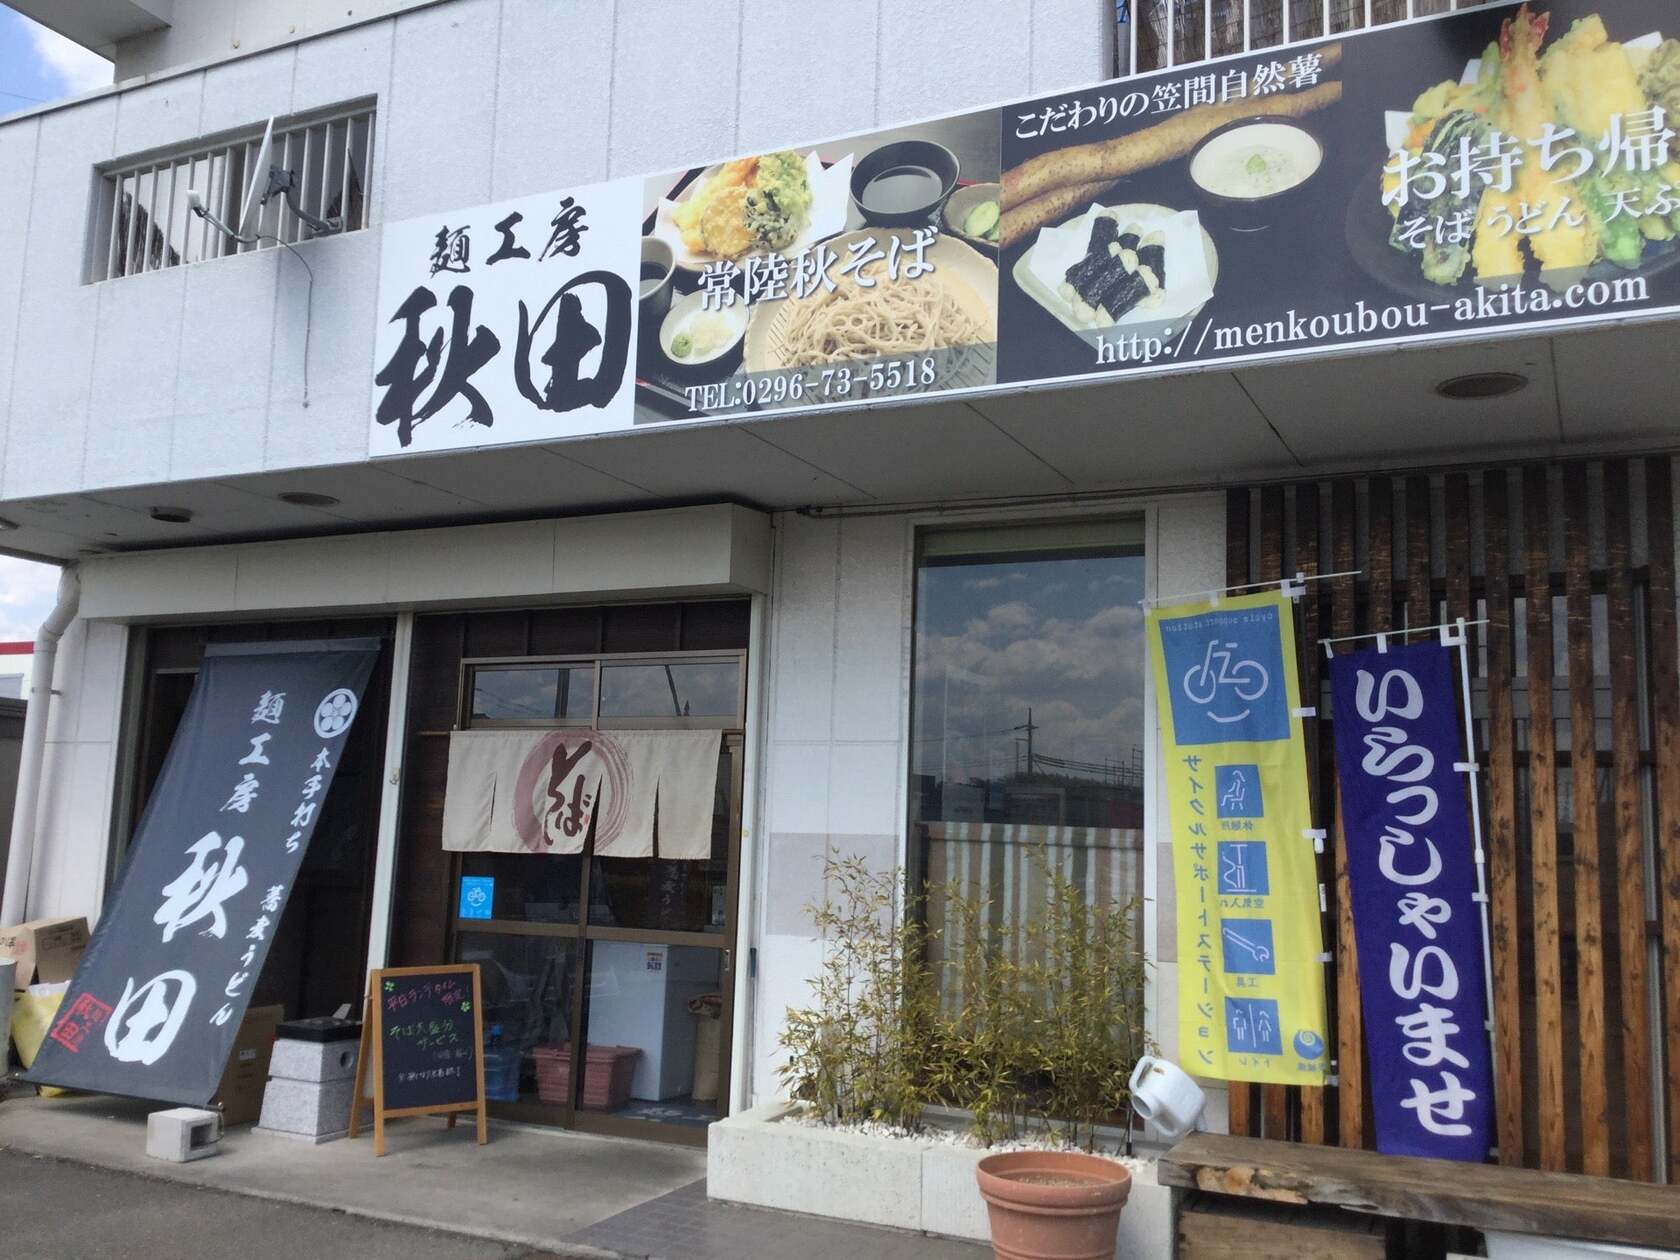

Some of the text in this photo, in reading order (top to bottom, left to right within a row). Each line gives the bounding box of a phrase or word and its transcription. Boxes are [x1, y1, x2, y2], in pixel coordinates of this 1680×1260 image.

[1015, 52, 1323, 138] こだわりの笠間自然薯
[429, 196, 590, 277] 麺工房
[1399, 208, 1474, 249] そば
[1487, 196, 1585, 238] うどん
[697, 225, 939, 312] 常陸秋そば
[375, 270, 633, 448] 秋田
[1096, 274, 1650, 366] http://menkoubou-akita.com
[685, 357, 936, 412] TEL:0296-73-5518
[544, 740, 593, 846] そば
[104, 689, 287, 1066] 麺工房 秋田
